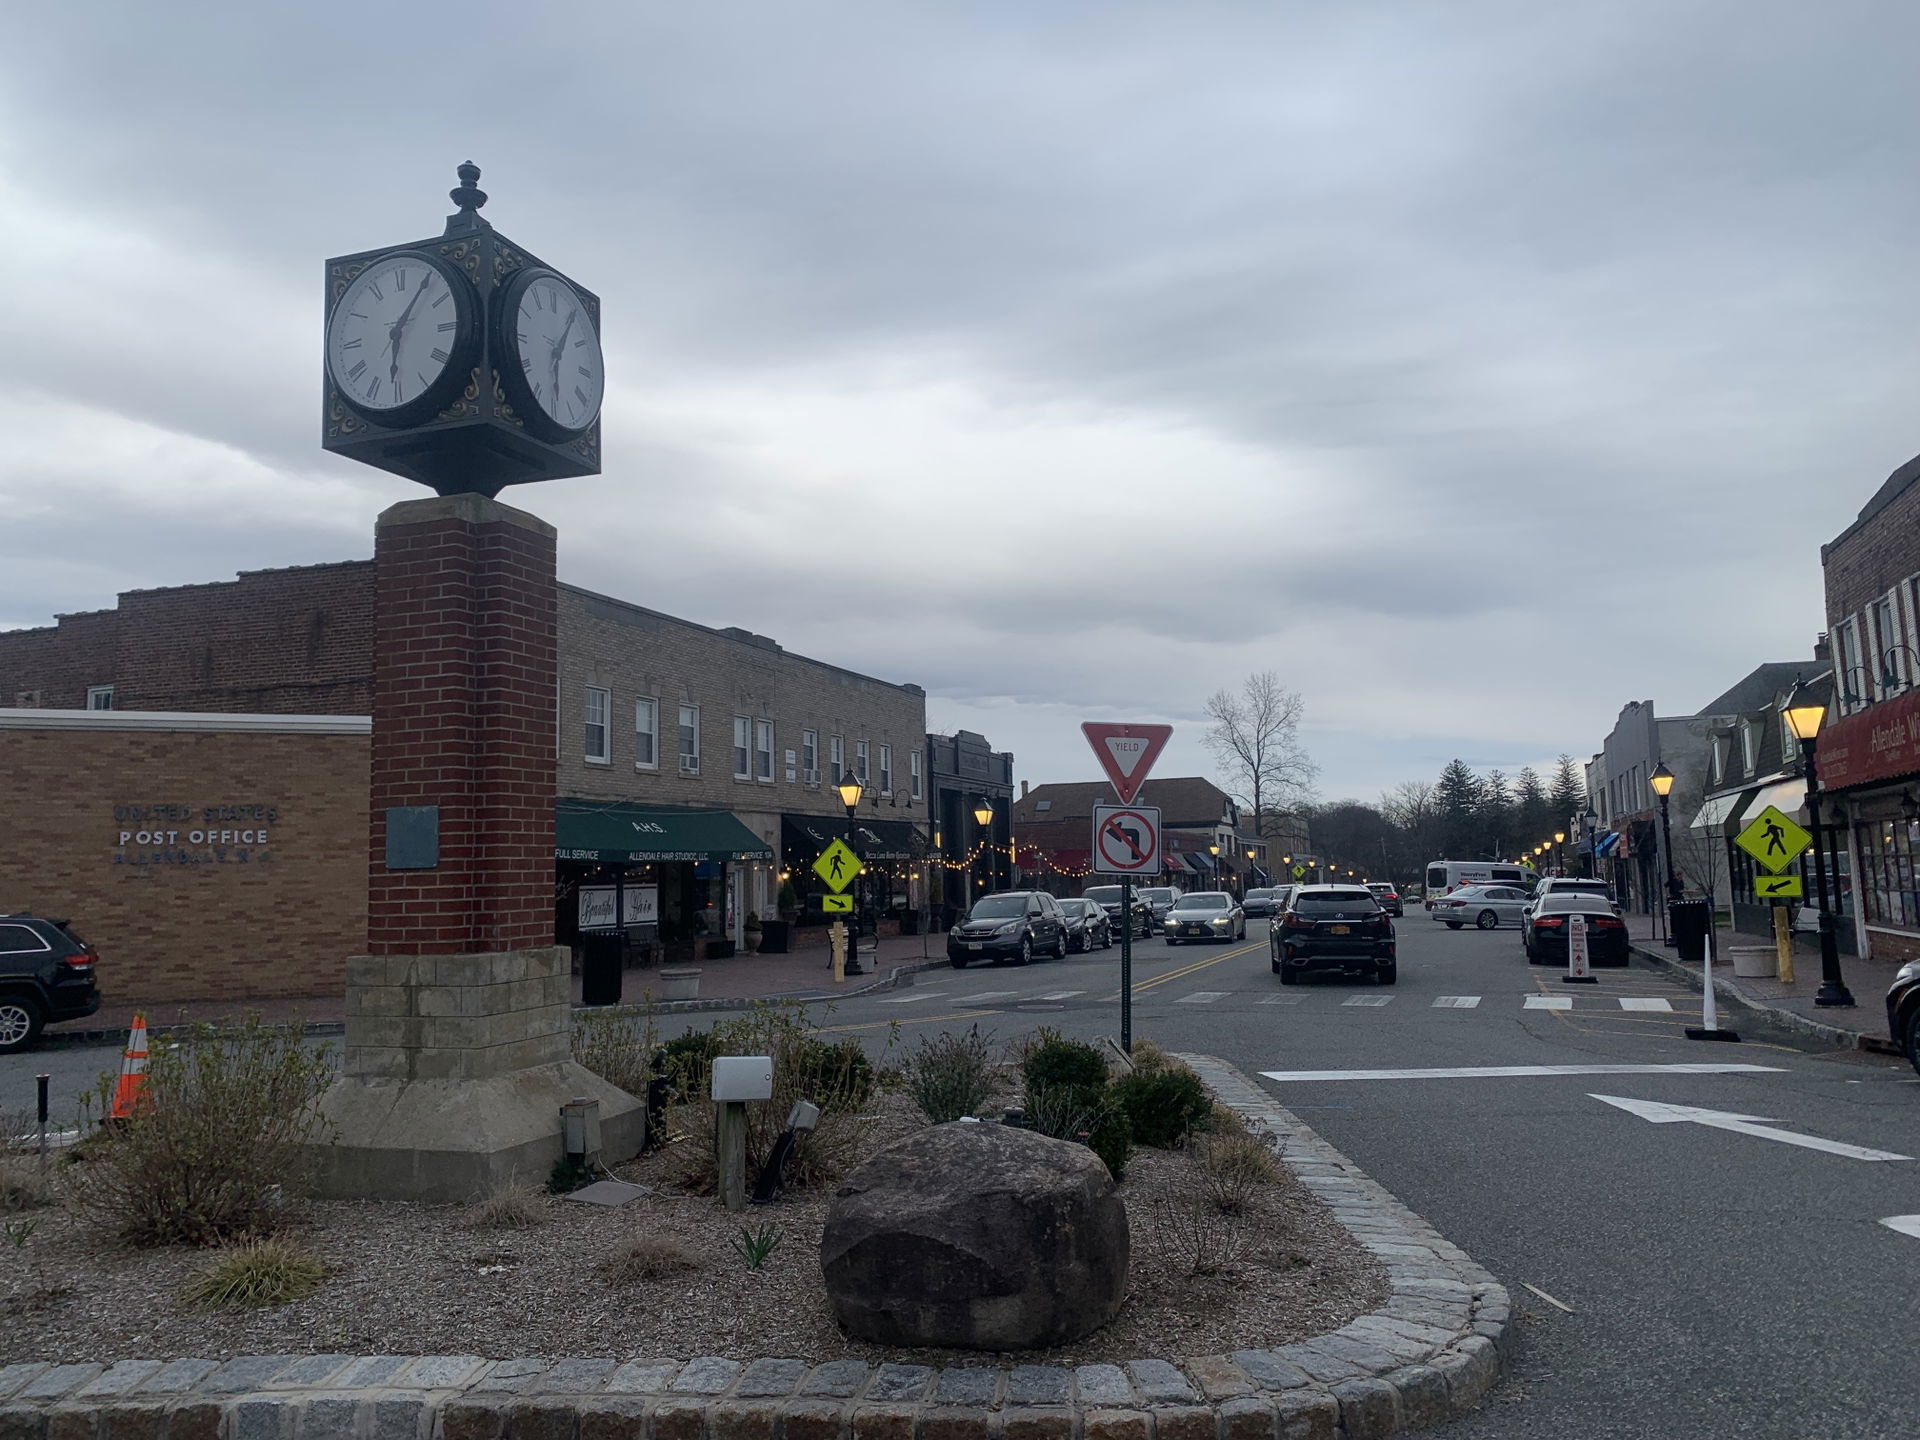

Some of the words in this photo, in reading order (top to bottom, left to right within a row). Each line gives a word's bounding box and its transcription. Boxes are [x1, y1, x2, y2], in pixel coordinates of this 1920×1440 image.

[1872, 718, 1906, 752] Allendale
[1115, 742, 1139, 752] YIELD
[114, 806, 192, 821] UNTED
[203, 805, 278, 821] STATES
[119, 831, 178, 845] POST
[188, 829, 268, 844] OFFICE
[554, 848, 571, 859] FULL
[572, 849, 599, 860] SERVICE
[629, 851, 660, 861] ALLENDALE
[661, 852, 674, 861] HAIR
[580, 891, 616, 924] Beautiful
[629, 889, 653, 920] Hair
